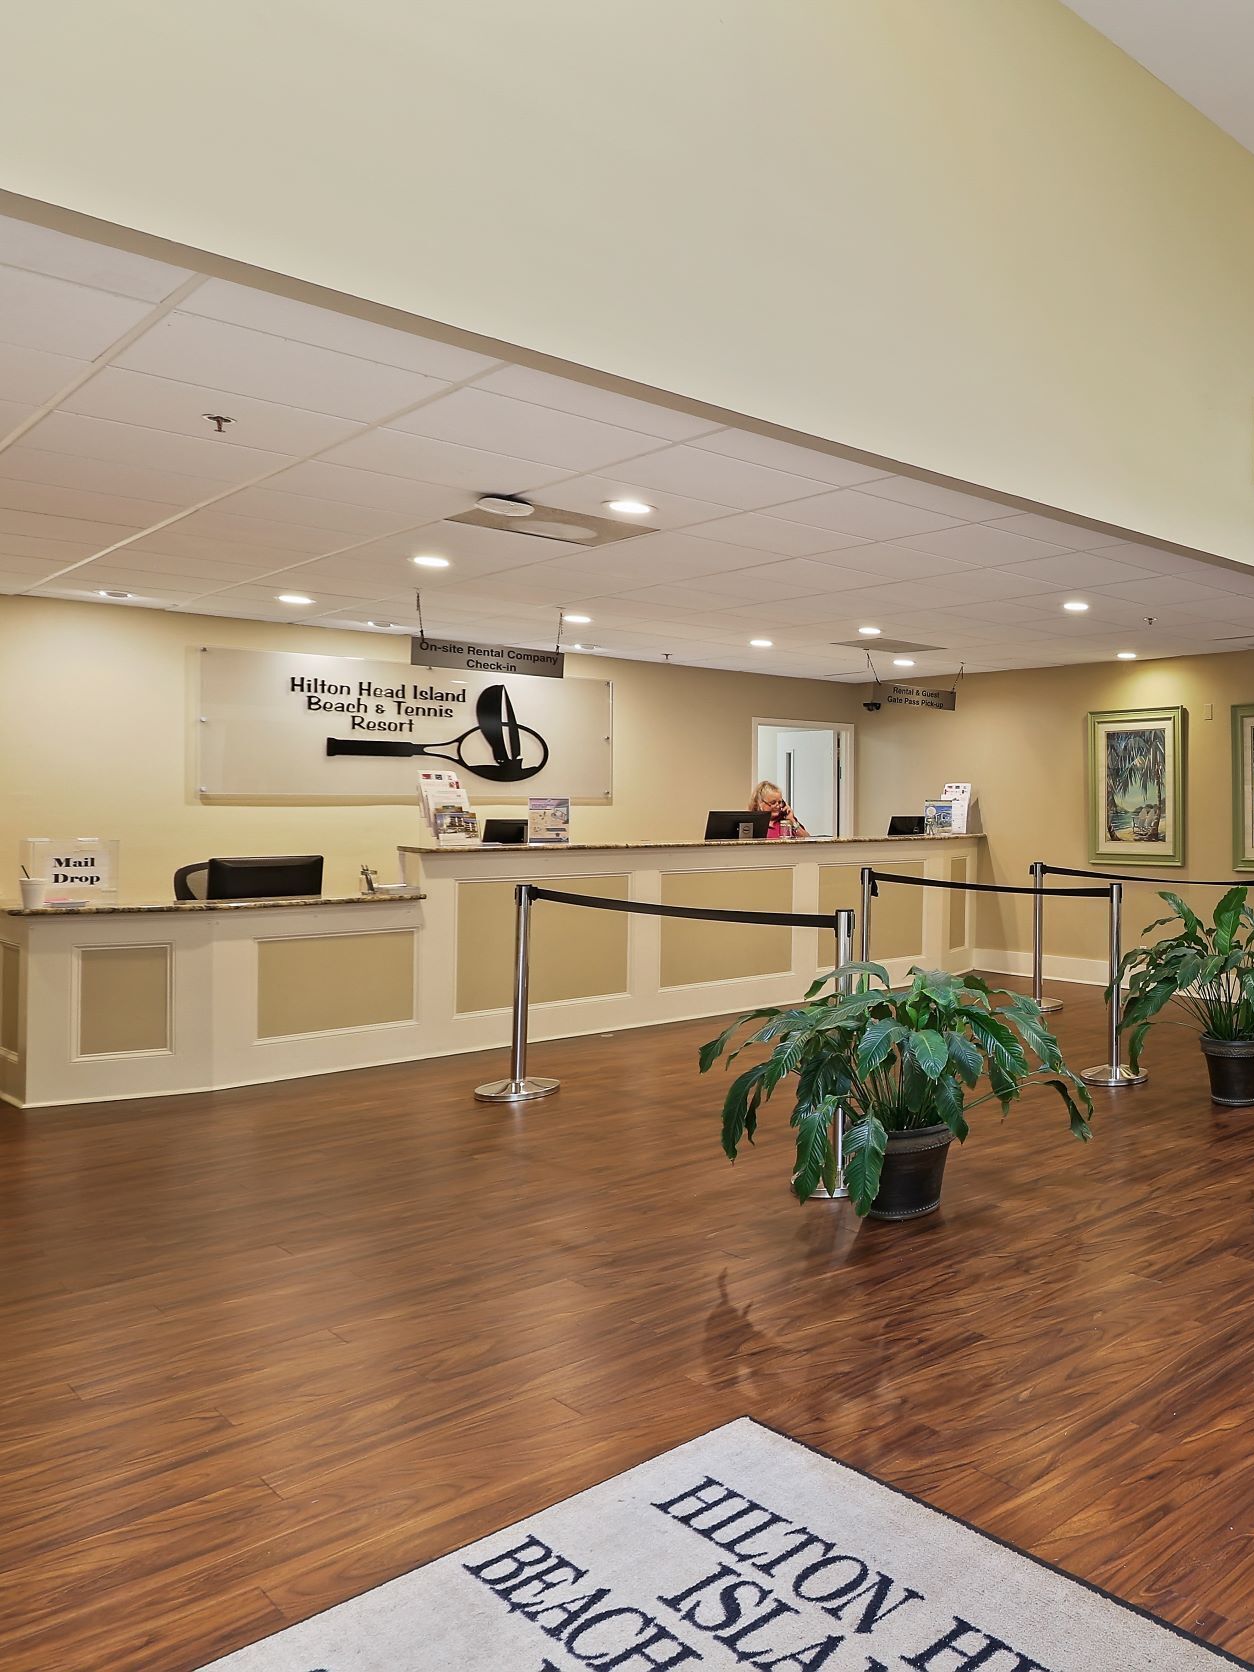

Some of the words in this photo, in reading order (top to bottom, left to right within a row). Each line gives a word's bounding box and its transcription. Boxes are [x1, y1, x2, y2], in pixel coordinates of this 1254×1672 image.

[419, 641, 463, 654] On-site
[467, 646, 504, 658] Rental
[507, 651, 558, 665] Company
[466, 659, 517, 672] Check-in
[290, 676, 351, 695] Hilton
[358, 681, 406, 699] Head
[412, 685, 467, 703] Island
[893, 686, 914, 696] Rental
[921, 690, 940, 699] Guest
[306, 695, 368, 714] Beach
[375, 703, 386, 715] &
[393, 700, 454, 718] Tennis
[887, 695, 903, 704] Gate
[904, 697, 920, 706] Pass
[921, 699, 944, 710] Pick-up
[350, 715, 415, 733] Resort
[52, 857, 96, 868] Mail
[51, 873, 101, 885] Drop
[650, 1475, 925, 1634] HILTON
[461, 1533, 704, 1672] BEACH
[656, 1562, 889, 1672] ISLA
